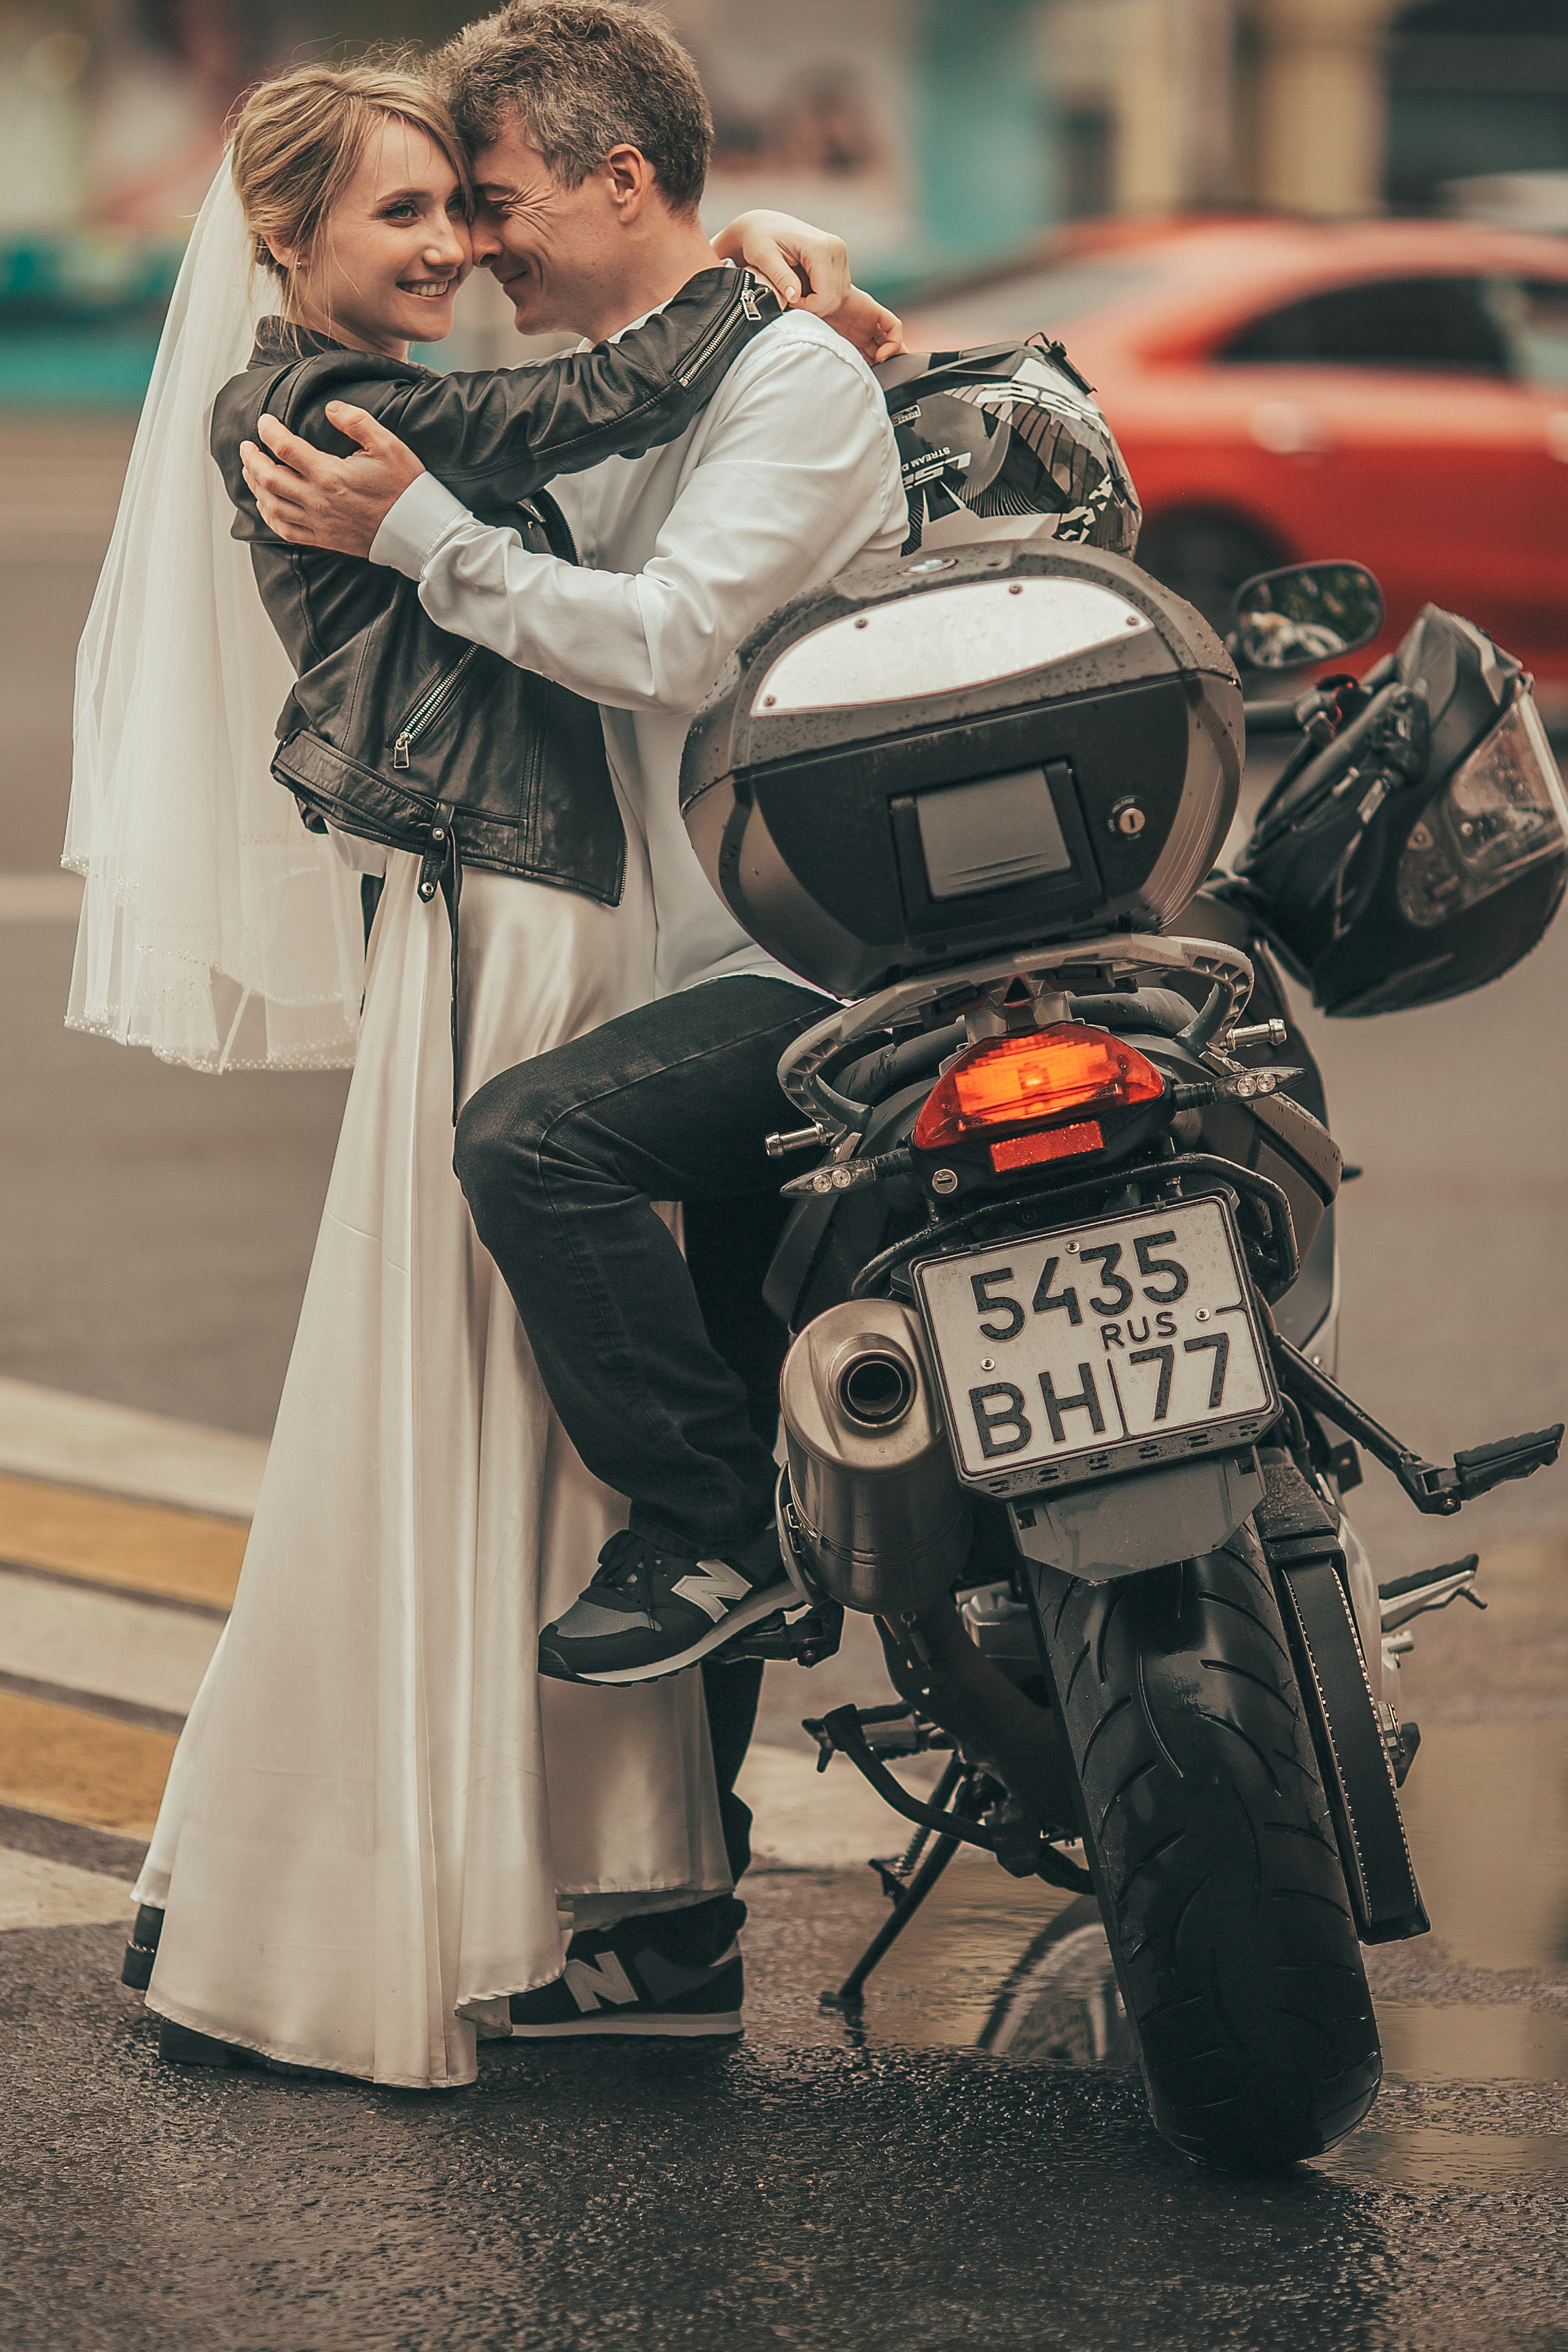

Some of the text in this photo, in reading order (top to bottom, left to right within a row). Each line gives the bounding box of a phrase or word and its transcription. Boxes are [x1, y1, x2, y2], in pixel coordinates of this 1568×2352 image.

[910, 447, 951, 468] STREAM
[970, 1229, 1189, 1342] 5435
[1100, 1311, 1177, 1349] RUS
[968, 1332, 1230, 1459] BH 77
[671, 1559, 753, 1623] N
[562, 1951, 639, 2013] N
